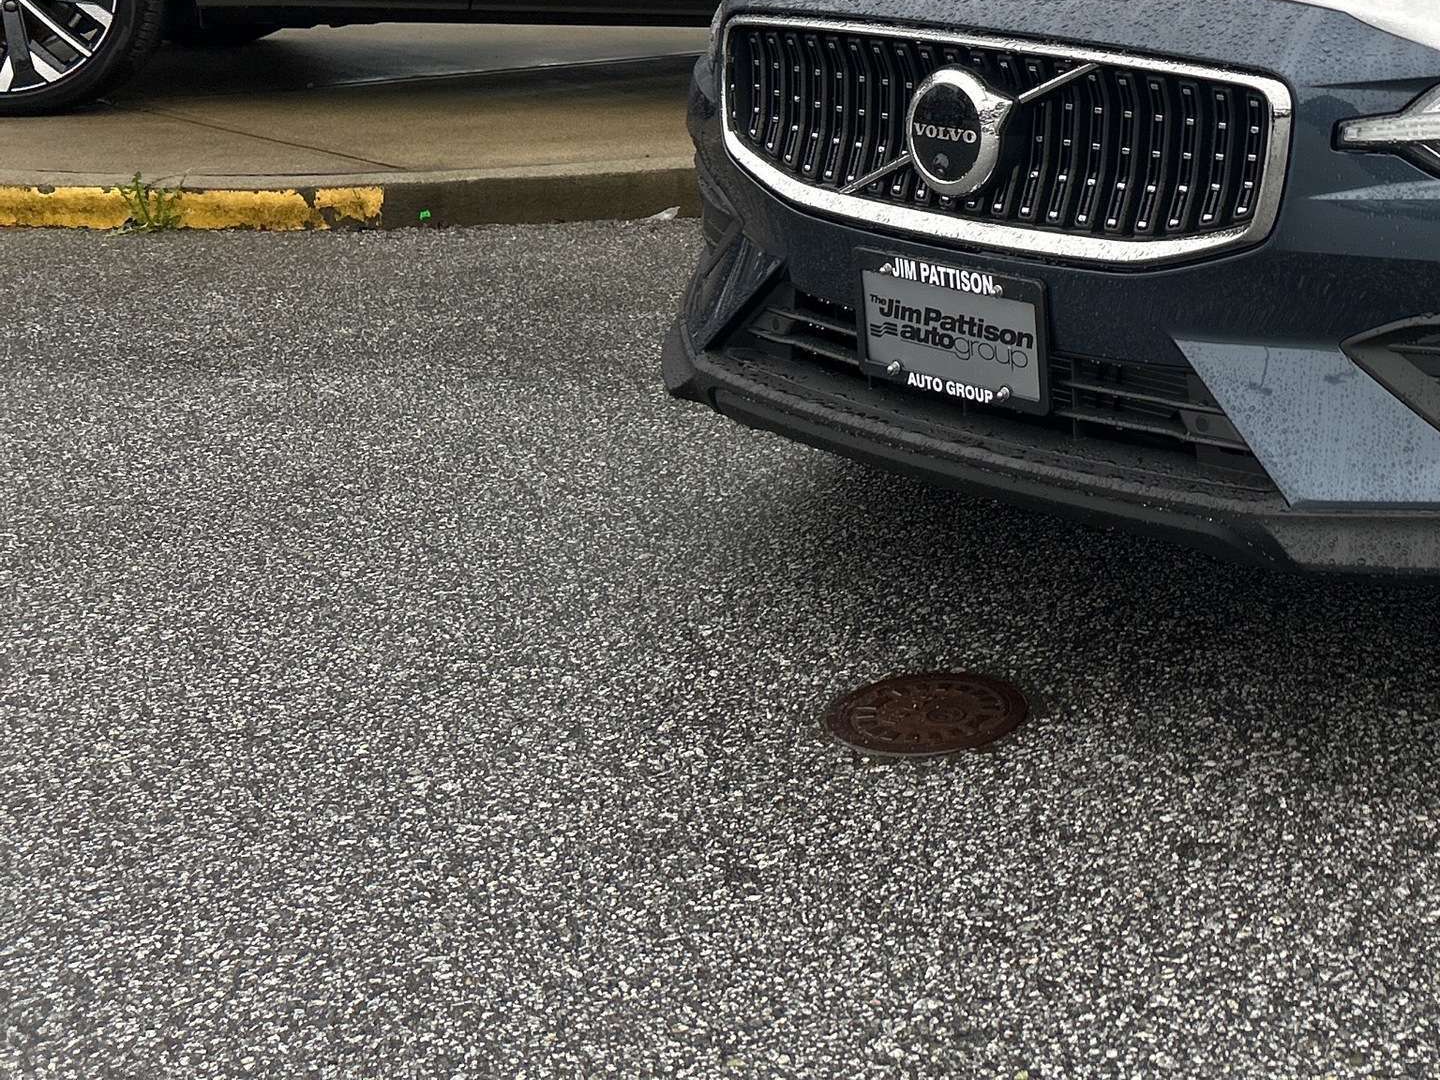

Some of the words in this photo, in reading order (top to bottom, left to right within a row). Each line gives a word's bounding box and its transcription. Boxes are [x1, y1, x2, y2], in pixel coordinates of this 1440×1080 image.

[914, 122, 977, 143] VOLVO
[892, 257, 918, 281] JIM
[919, 262, 995, 295] PATTISON
[870, 294, 887, 306] The
[907, 372, 943, 392] AUTO
[945, 381, 994, 403] GROUP
